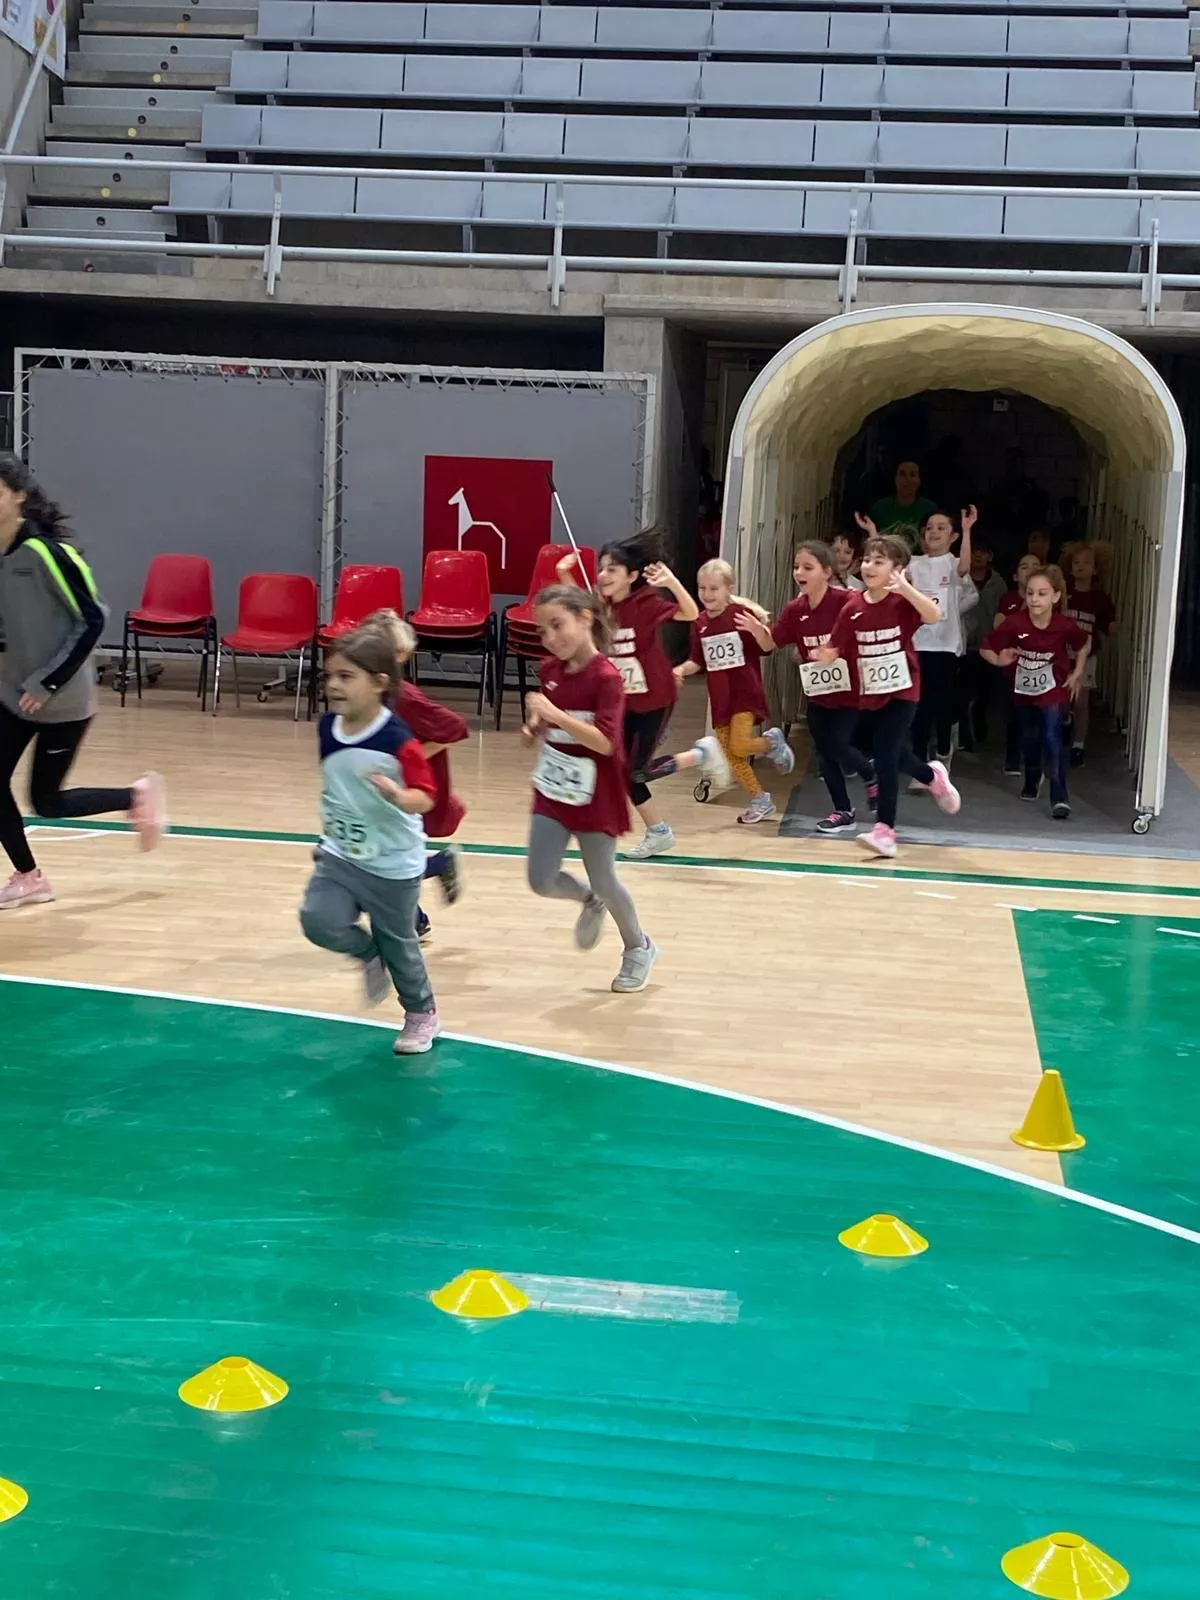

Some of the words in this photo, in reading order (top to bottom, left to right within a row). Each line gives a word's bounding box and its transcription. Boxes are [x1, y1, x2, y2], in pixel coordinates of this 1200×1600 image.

[708, 642, 736, 660] 203
[810, 667, 842, 685] 200
[868, 664, 900, 683] 202
[1022, 673, 1047, 688] 210
